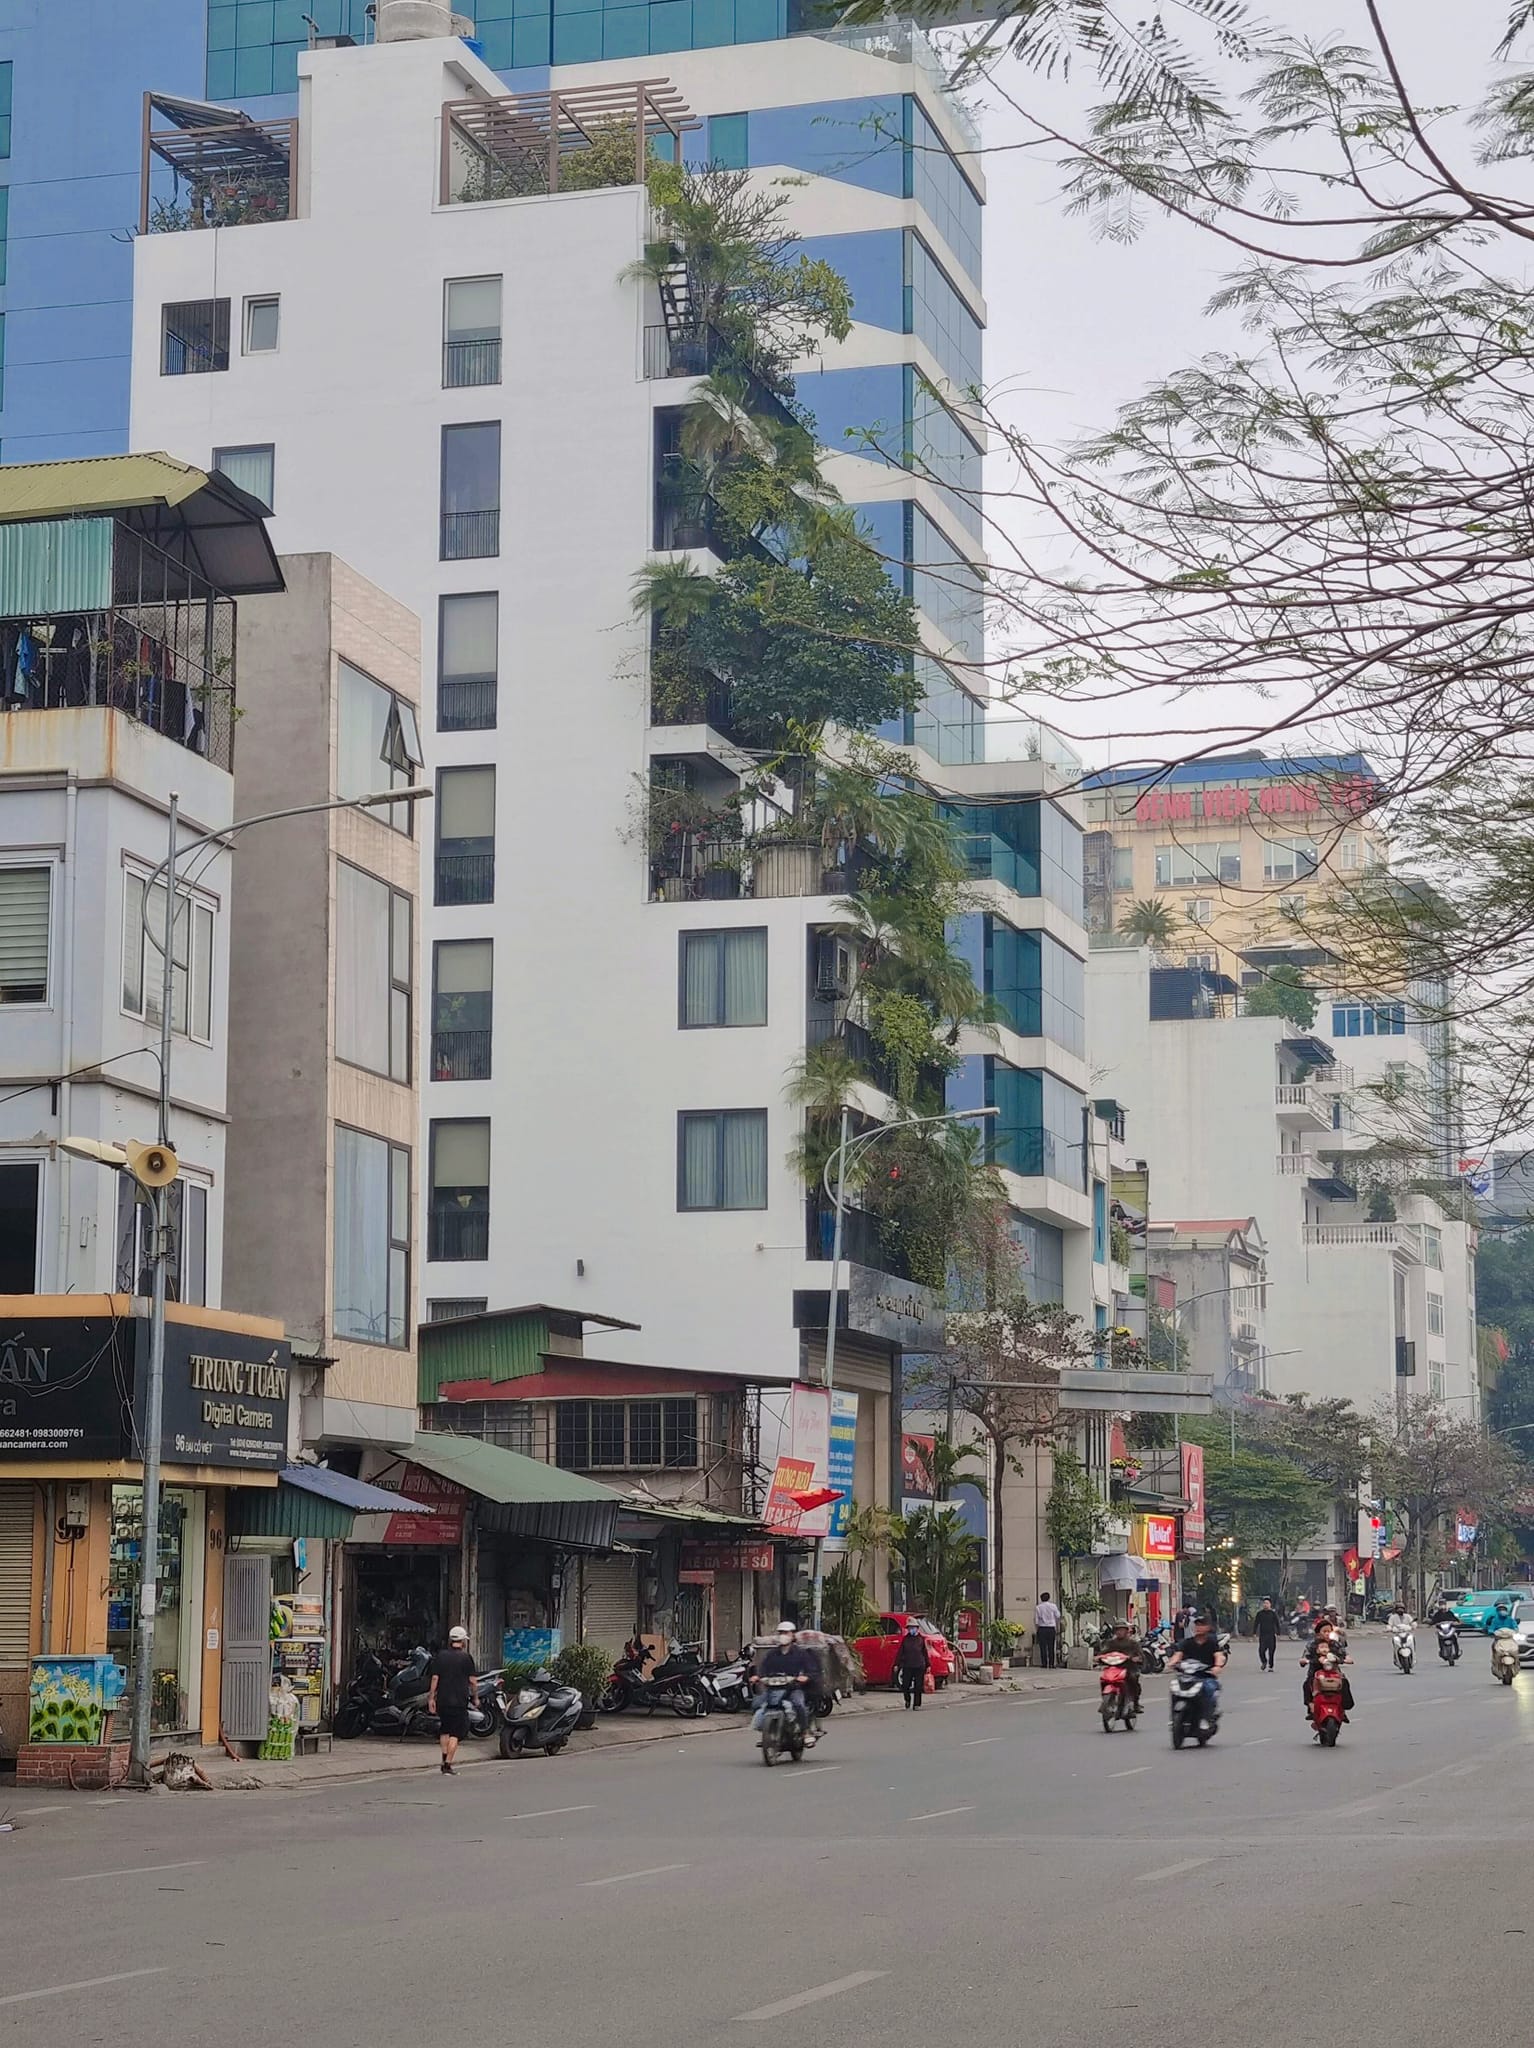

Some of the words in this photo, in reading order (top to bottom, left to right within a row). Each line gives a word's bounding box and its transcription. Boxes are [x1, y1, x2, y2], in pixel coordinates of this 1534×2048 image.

[1136, 788, 1192, 824] BỆNH
[1203, 784, 1249, 823] VIỆN
[190, 1354, 245, 1394] TRUNG
[245, 1349, 288, 1400] TUẤN
[204, 1400, 235, 1428] Digital
[237, 1404, 273, 1429] Camera
[175, 1434, 185, 1452] 96
[210, 1529, 222, 1550] 96
[732, 1555, 748, 1569] XE
[751, 1551, 770, 1569] SỐ
